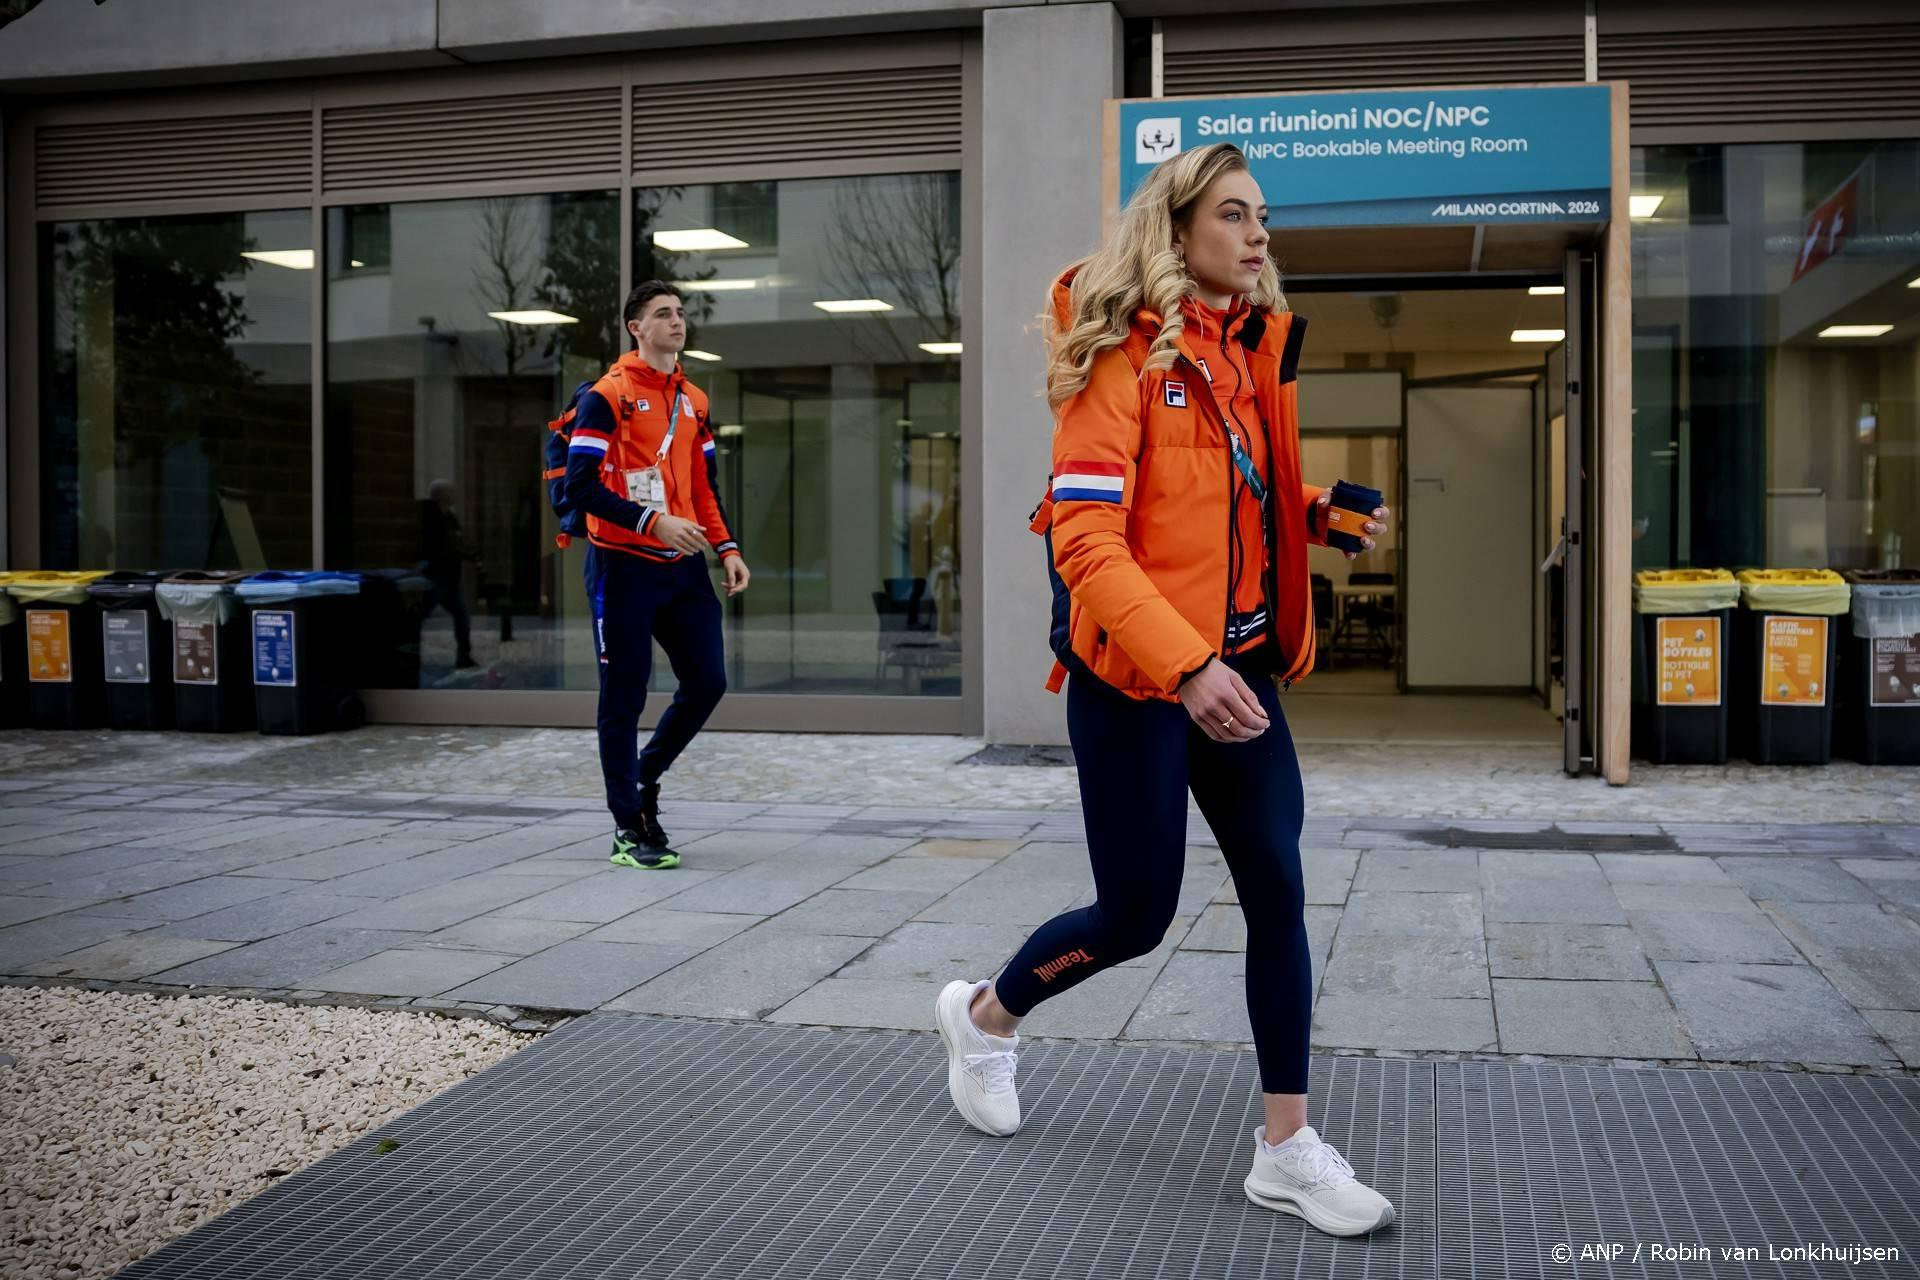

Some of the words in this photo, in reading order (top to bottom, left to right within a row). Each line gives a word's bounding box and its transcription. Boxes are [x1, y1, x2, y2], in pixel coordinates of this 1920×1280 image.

[1197, 113, 1253, 136] Sala
[1260, 107, 1358, 133] riunioni
[1363, 100, 1490, 132] NOC/NPC
[1242, 139, 1288, 159] /NPC
[1292, 138, 1382, 158] Bookable
[1387, 136, 1465, 159] Meeting
[1470, 136, 1528, 153] Room
[1431, 202, 1497, 217] MILANO
[1498, 201, 1566, 216] CORTINA
[1567, 200, 1600, 214] 2026
